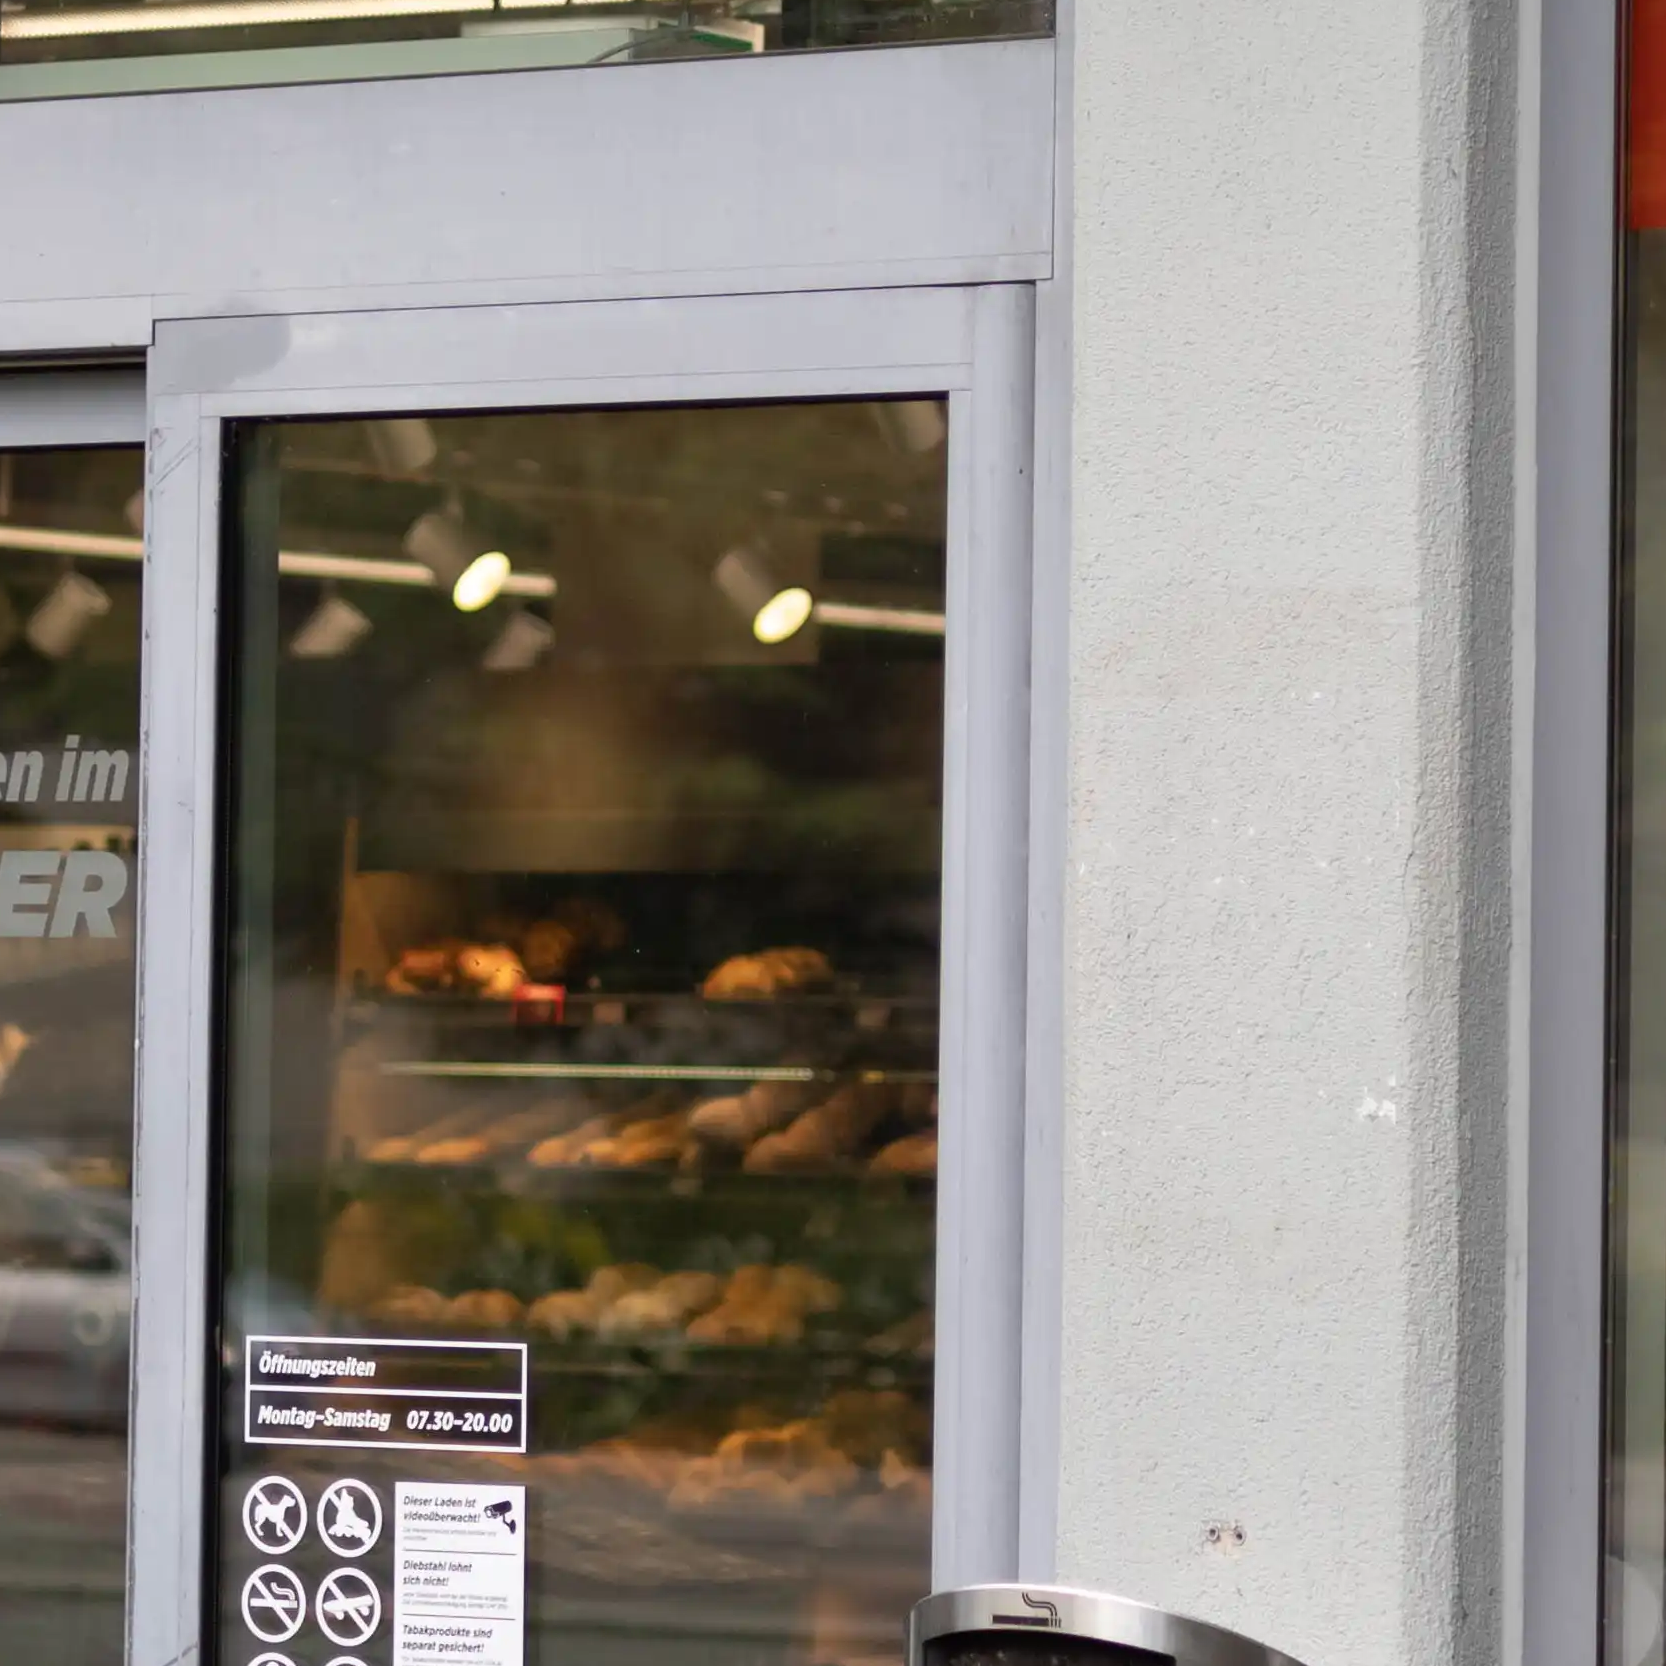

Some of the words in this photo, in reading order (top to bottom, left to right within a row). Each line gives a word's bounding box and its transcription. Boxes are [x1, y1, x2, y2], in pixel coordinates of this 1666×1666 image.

[55, 734, 130, 802] im
[258, 1349, 376, 1380] Öffnungszeiten
[257, 1404, 391, 1432] Montag-Samstag
[406, 1409, 513, 1434] 07.30-20.00
[403, 1495, 433, 1506] Dieser
[434, 1496, 463, 1507] Laden
[464, 1497, 477, 1508] ist
[403, 1511, 481, 1523] videoüberwacht!
[403, 1559, 447, 1571] Diebstahl
[448, 1561, 473, 1572] lohnt
[402, 1575, 421, 1586] sich
[422, 1576, 450, 1587] nicht!
[402, 1624, 471, 1637] Tabakprodukte
[472, 1628, 493, 1639] sind
[402, 1641, 436, 1652] separat
[438, 1642, 485, 1653] gesichert!
